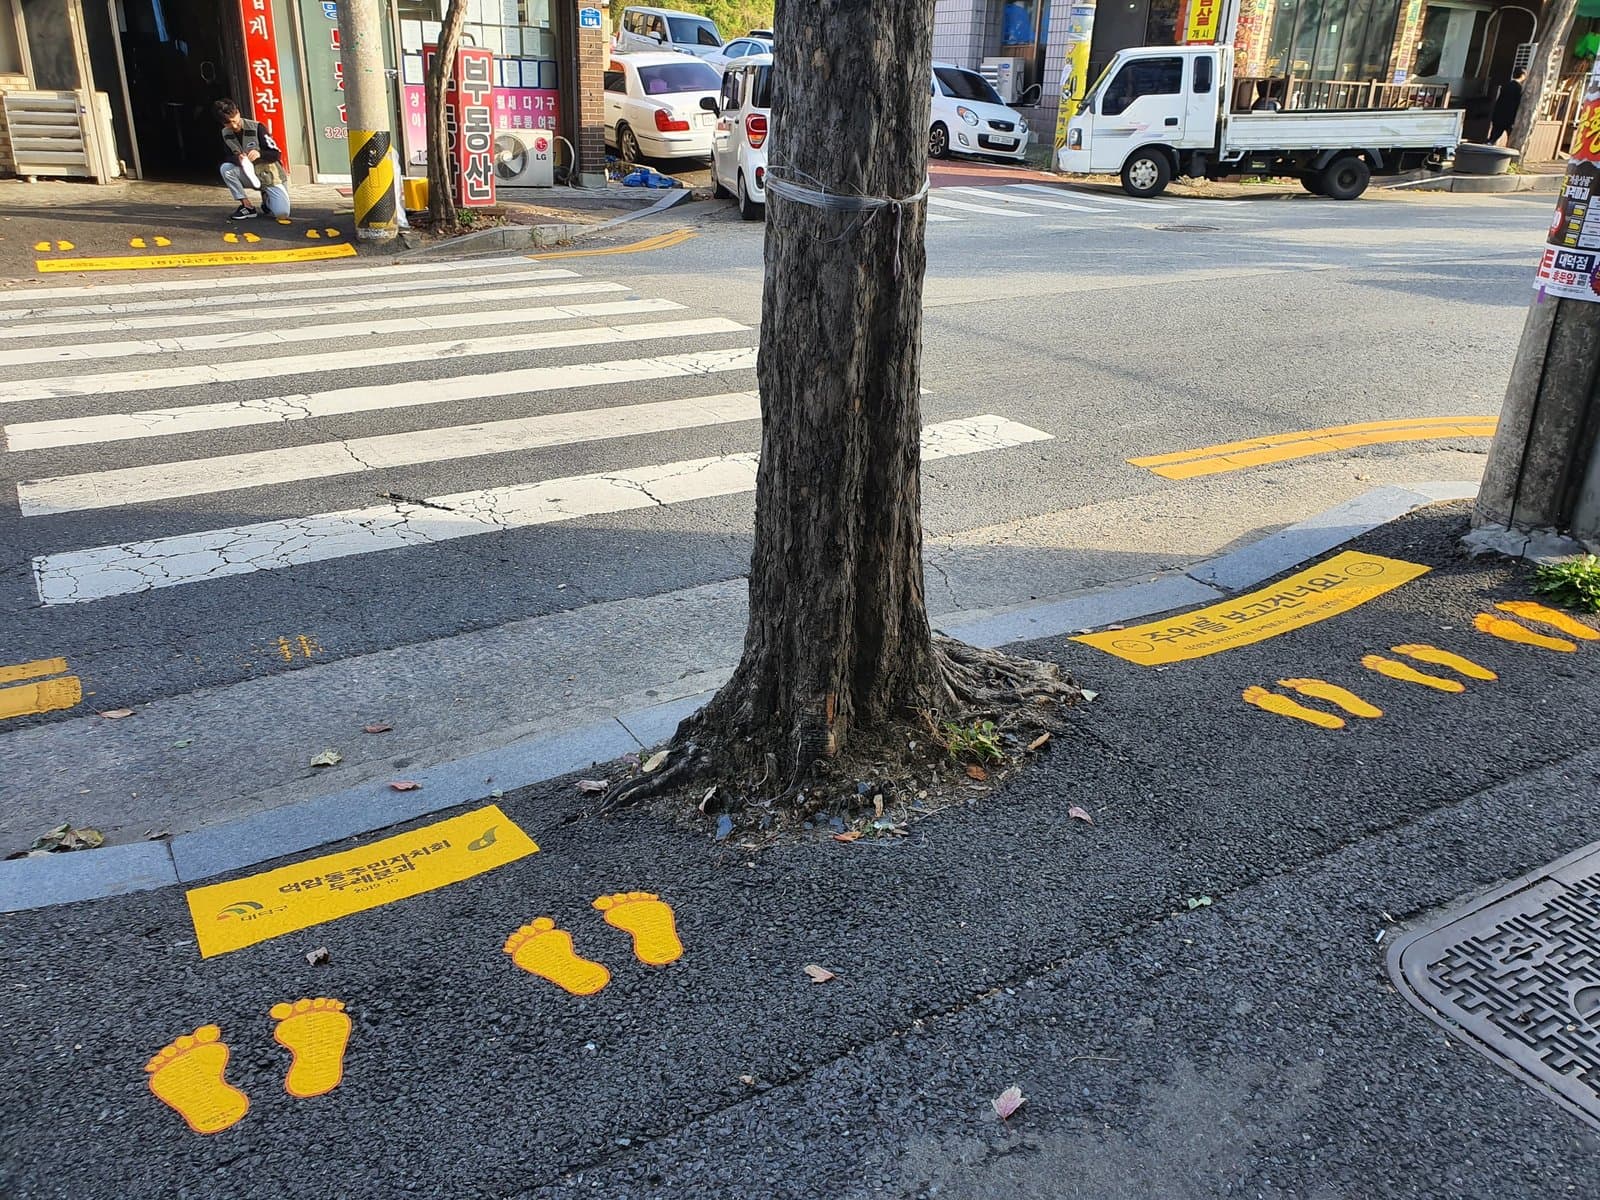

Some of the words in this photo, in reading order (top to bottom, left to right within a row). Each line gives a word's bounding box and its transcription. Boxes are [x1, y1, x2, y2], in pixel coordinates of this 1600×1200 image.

[462, 56, 494, 200] 부동산
[536, 153, 547, 161] LG
[1558, 253, 1590, 271] 대덕점
[1142, 616, 1234, 644] 주위를
[278, 839, 452, 894] 덕암동주민자치회
[329, 862, 417, 893] 두레분과
